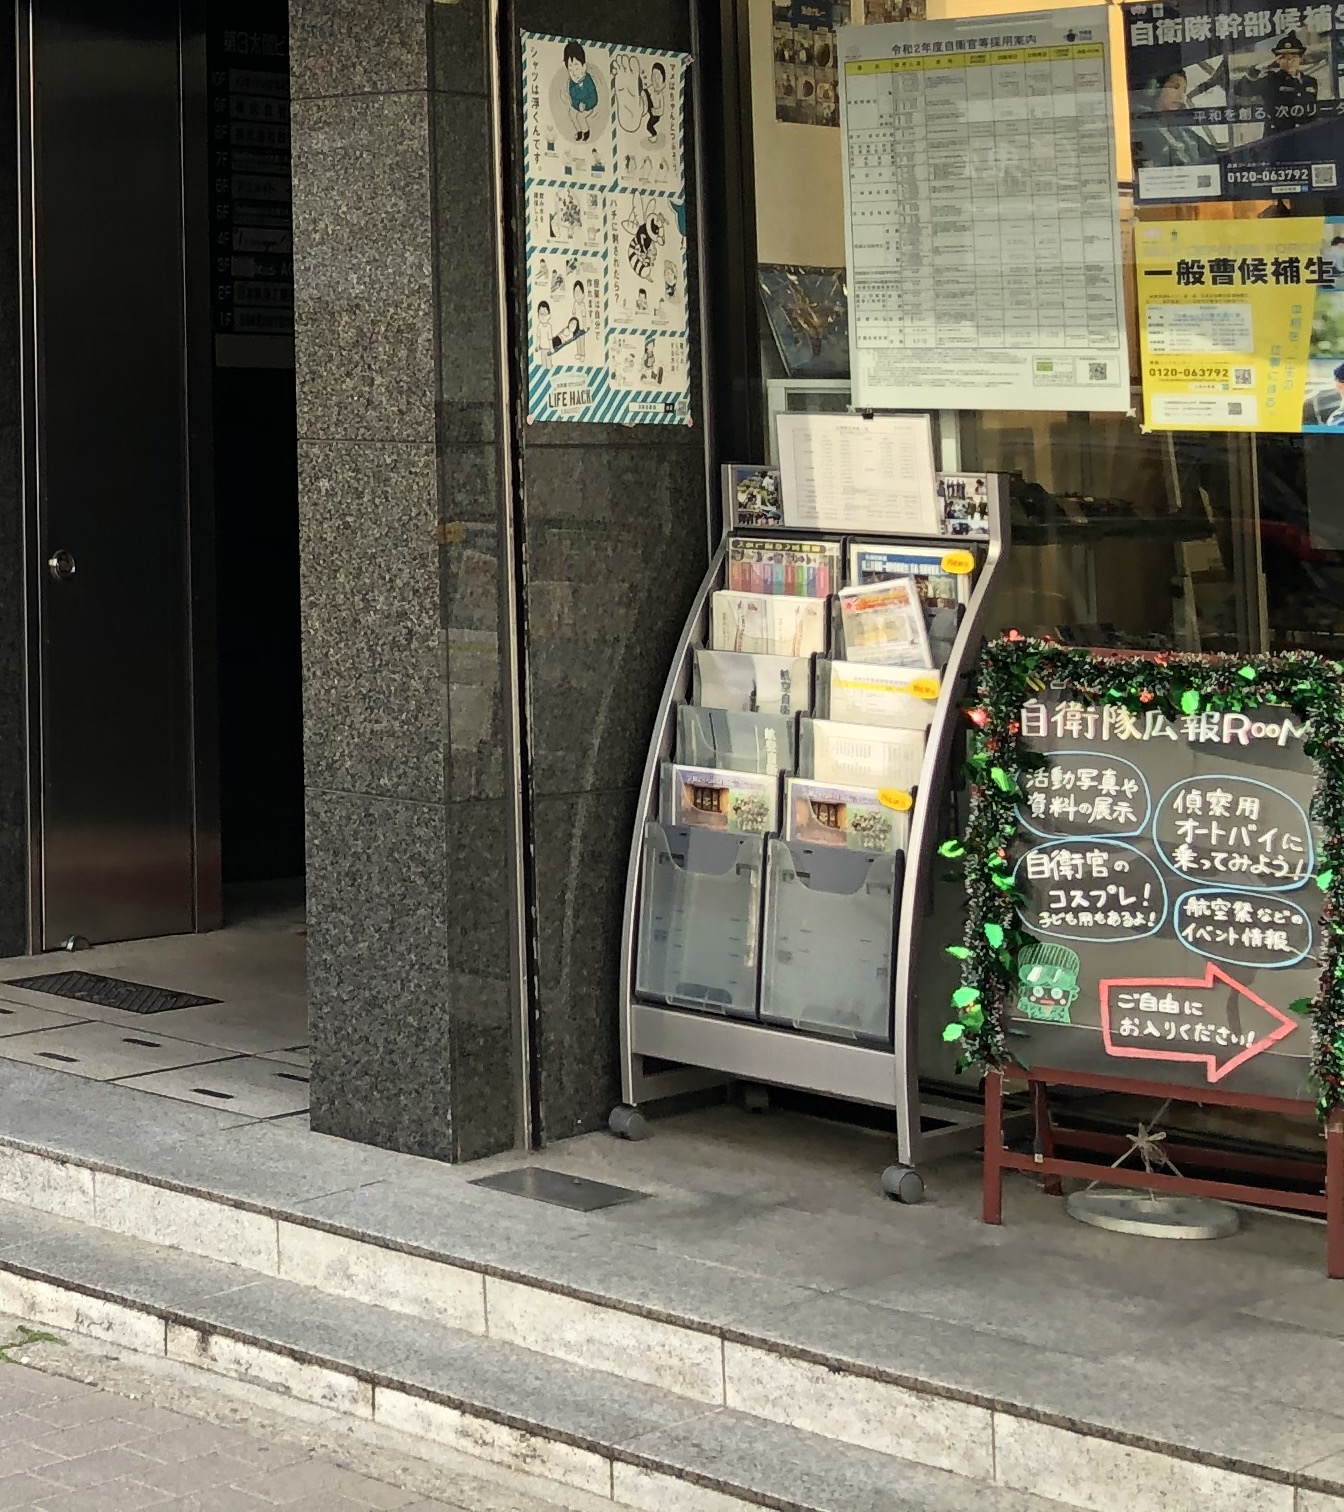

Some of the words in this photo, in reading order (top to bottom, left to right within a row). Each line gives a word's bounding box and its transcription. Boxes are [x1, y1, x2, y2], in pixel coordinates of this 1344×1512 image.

[1227, 169, 1309, 183] 0120-063792
[1144, 257, 1336, 286] 一般曹候補生
[1149, 368, 1229, 378] 0120-063792
[548, 391, 567, 408] LIFE
[567, 389, 592, 406] HACK
[1025, 768, 1139, 799] 活動写真や
[1027, 793, 1138, 824] 資料の展示
[1172, 787, 1261, 818] 偵察用
[1175, 818, 1304, 853] オートバイに
[1026, 849, 1130, 881] 自衛官の
[1171, 844, 1305, 880] 乗ってみよう!
[1048, 882, 1152, 909] コスプレ!
[1038, 911, 1157, 928] 子ども用もあるよ!
[1183, 896, 1303, 926] 航空祭などの
[1181, 922, 1289, 950] イベント情報
[1117, 992, 1204, 1016] ご自由に
[1119, 1016, 1256, 1048] お入りください!
